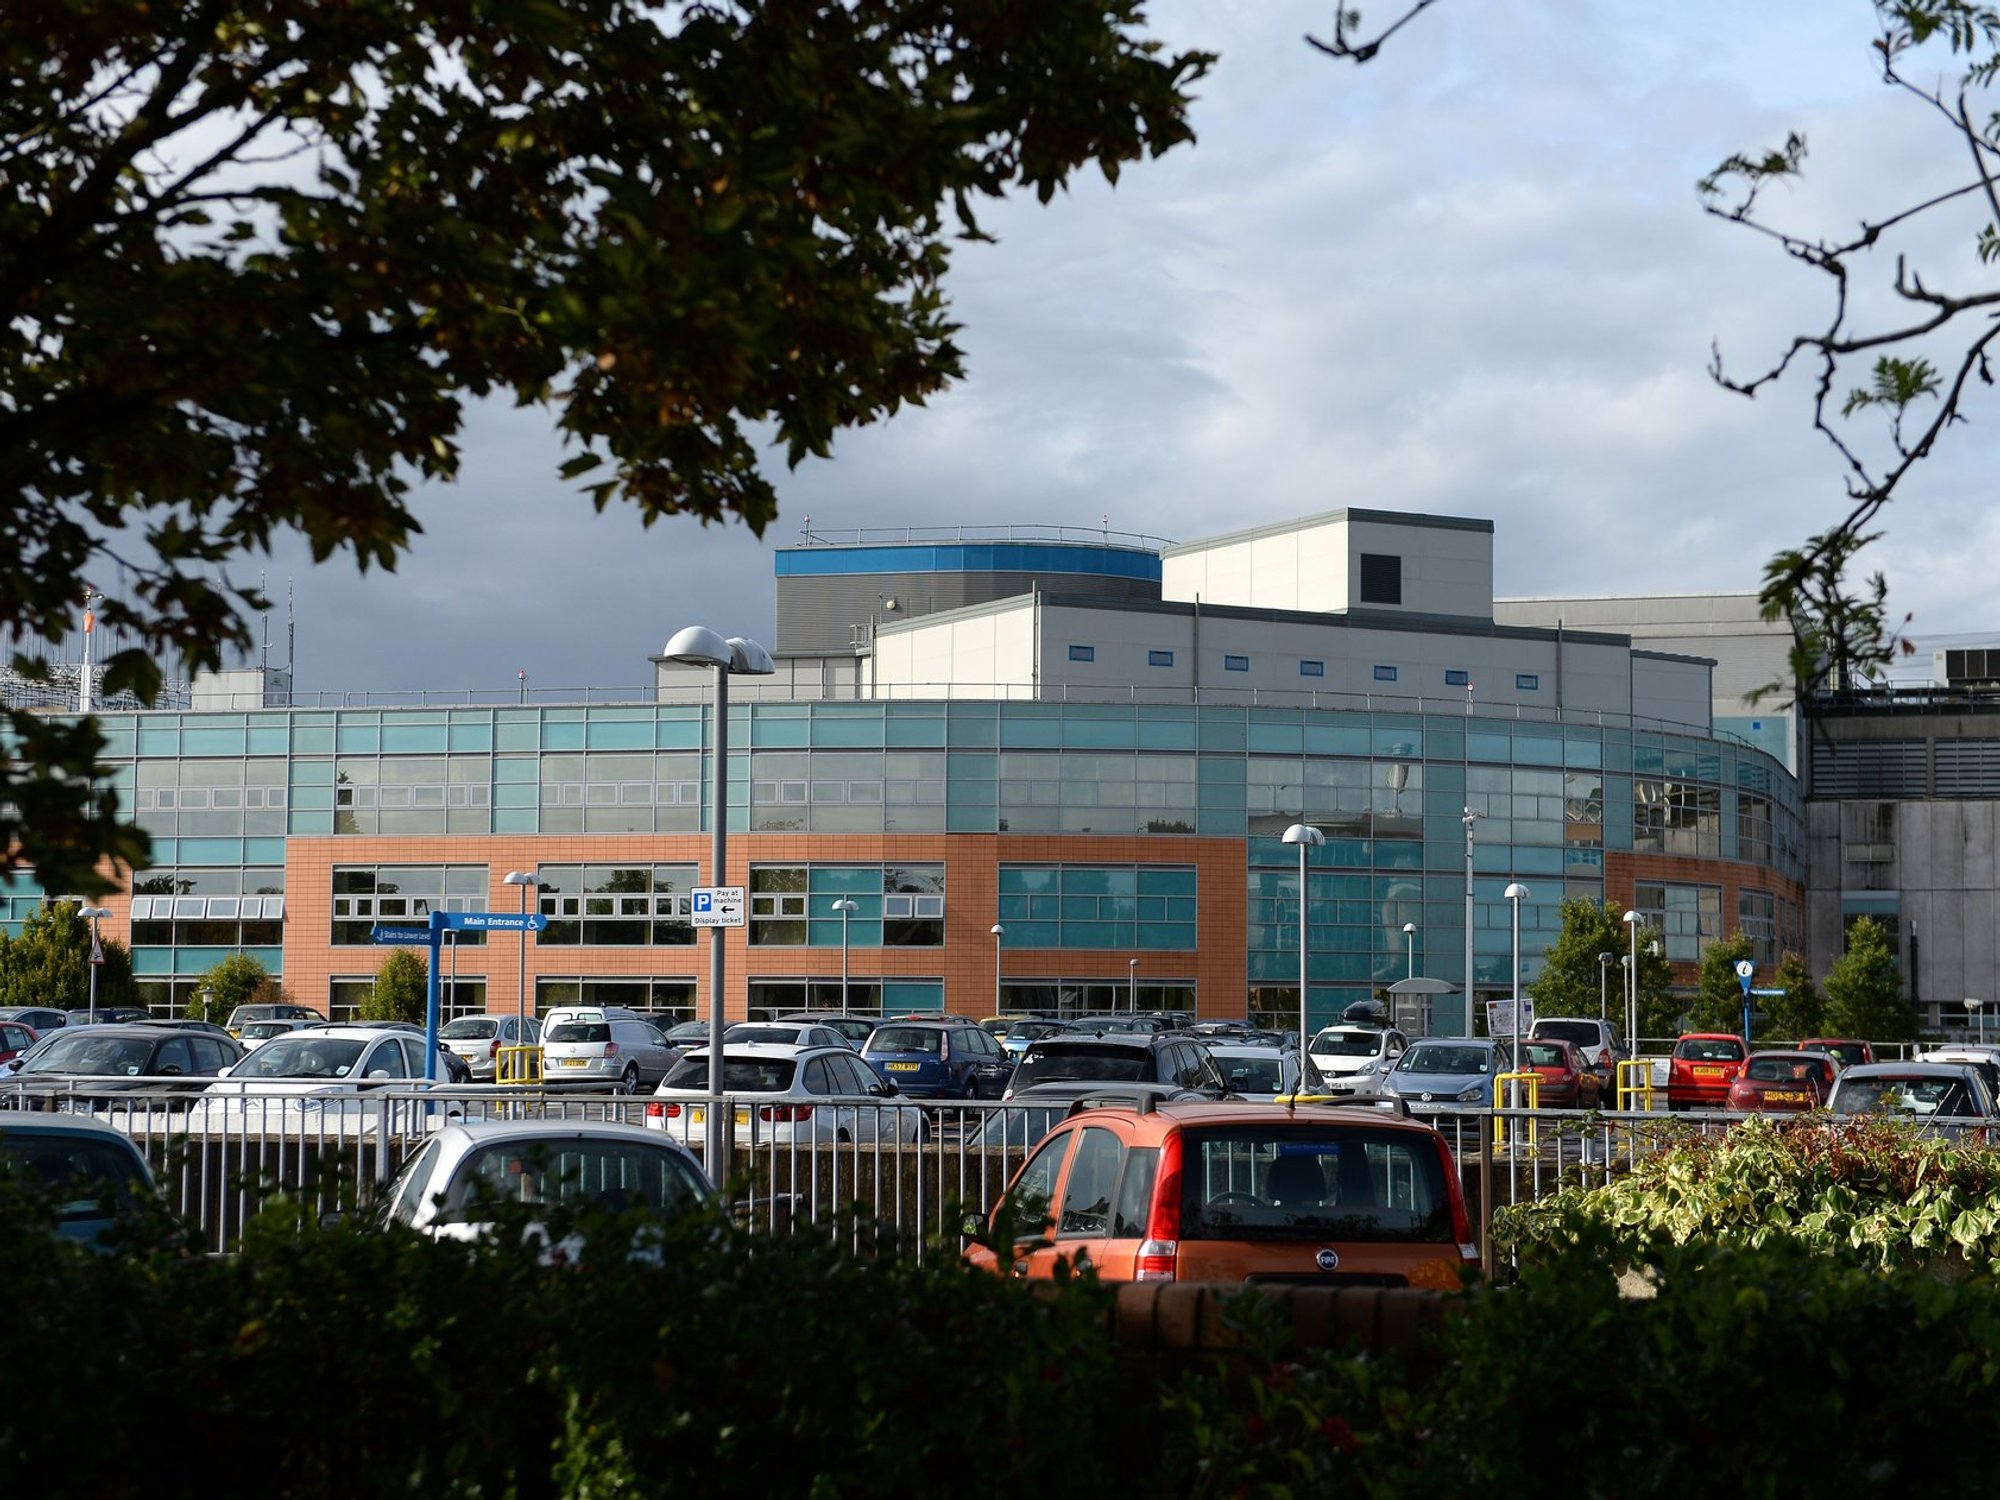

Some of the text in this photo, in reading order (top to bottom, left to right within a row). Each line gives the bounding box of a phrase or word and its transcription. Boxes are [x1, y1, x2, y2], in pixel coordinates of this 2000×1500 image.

[697, 895, 710, 911] P
[464, 917, 524, 926] Main Entrance
[694, 917, 720, 925] Display
